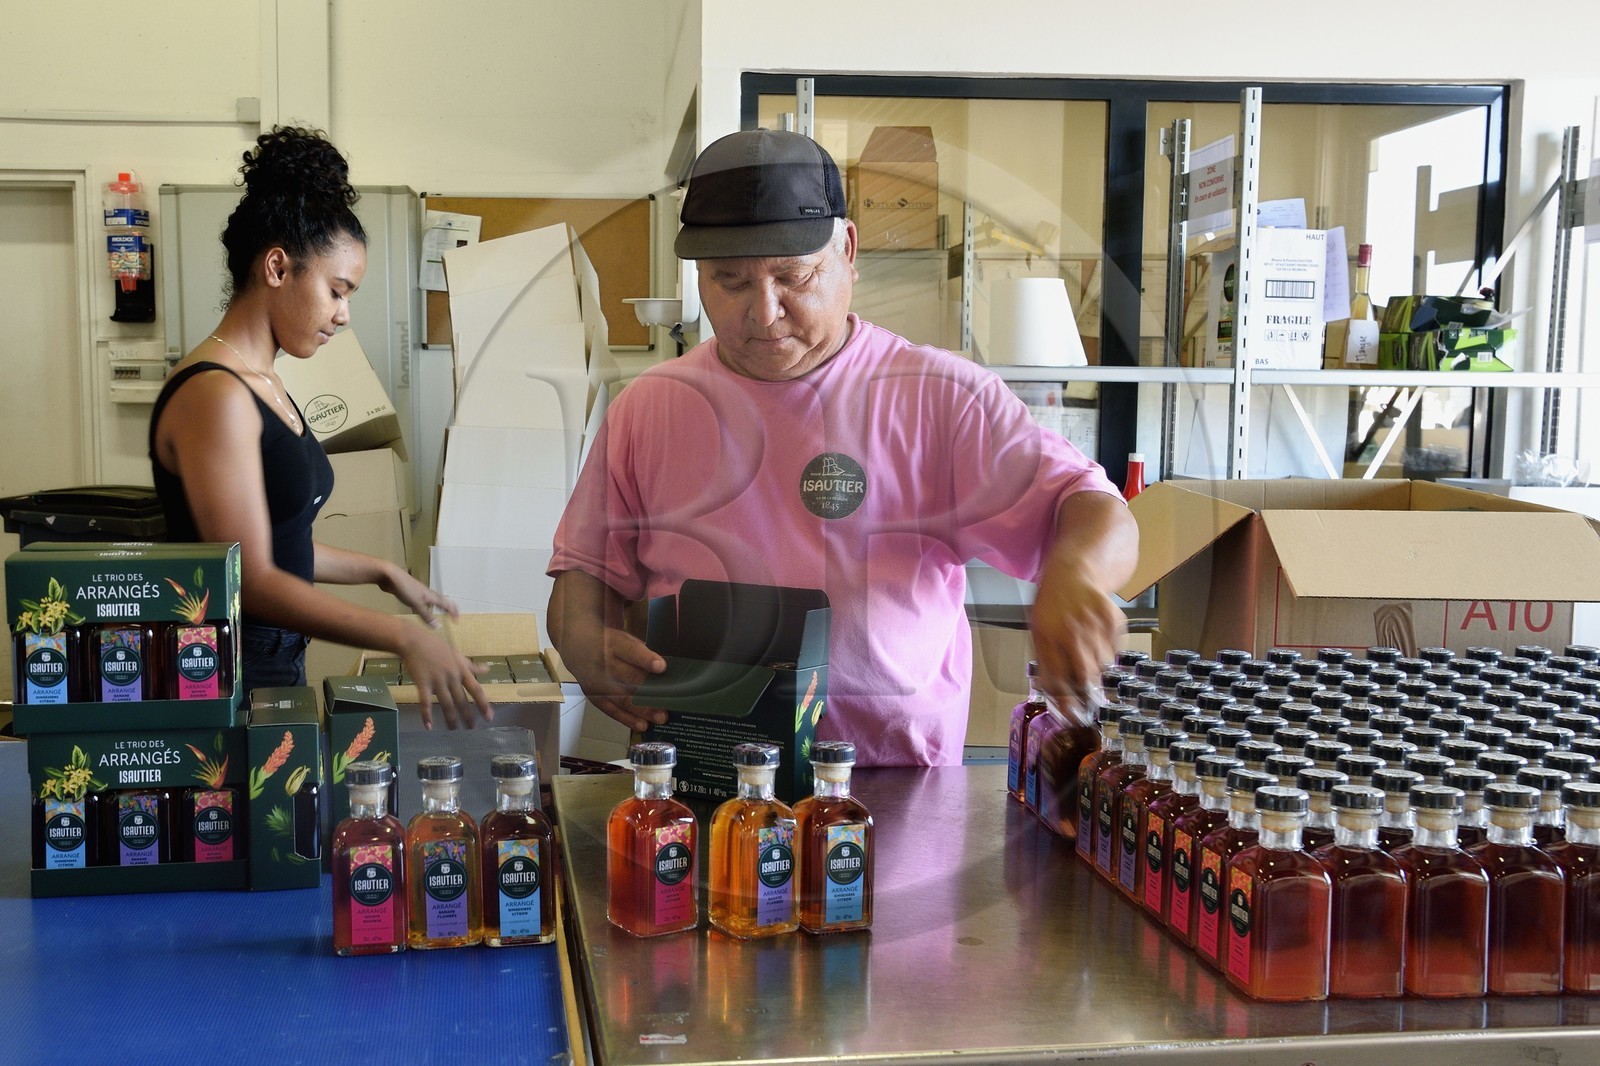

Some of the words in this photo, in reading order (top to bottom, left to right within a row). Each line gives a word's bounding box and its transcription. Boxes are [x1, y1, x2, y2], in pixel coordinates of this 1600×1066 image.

[1266, 315, 1311, 325] FRAGILE
[396, 321, 410, 389] legrand
[308, 404, 345, 424] ISAUTIER
[803, 480, 864, 493] ISAUTIER
[822, 501, 840, 511] 1845
[76, 582, 160, 600] ARRANGÉS
[97, 603, 140, 618] ISAUTIER
[30, 663, 63, 673] ISAUTIER
[105, 662, 138, 672] ISAUTIER
[182, 657, 214, 668] ISAUTIER
[99, 748, 181, 767] ARRANGÉS
[119, 769, 161, 783] ISAUTIER
[123, 826, 155, 836] ISAUTIER
[198, 821, 229, 831] ISAUTIER
[49, 828, 82, 838] ISAUTIER
[659, 857, 687, 871] ISAUTIER
[762, 860, 790, 873] ISAUTIER
[830, 858, 860, 870] ISAUTIER
[430, 874, 462, 886] ISAUTIER
[502, 872, 536, 884] ISAUTIER
[355, 879, 389, 890] ISAUTIER
